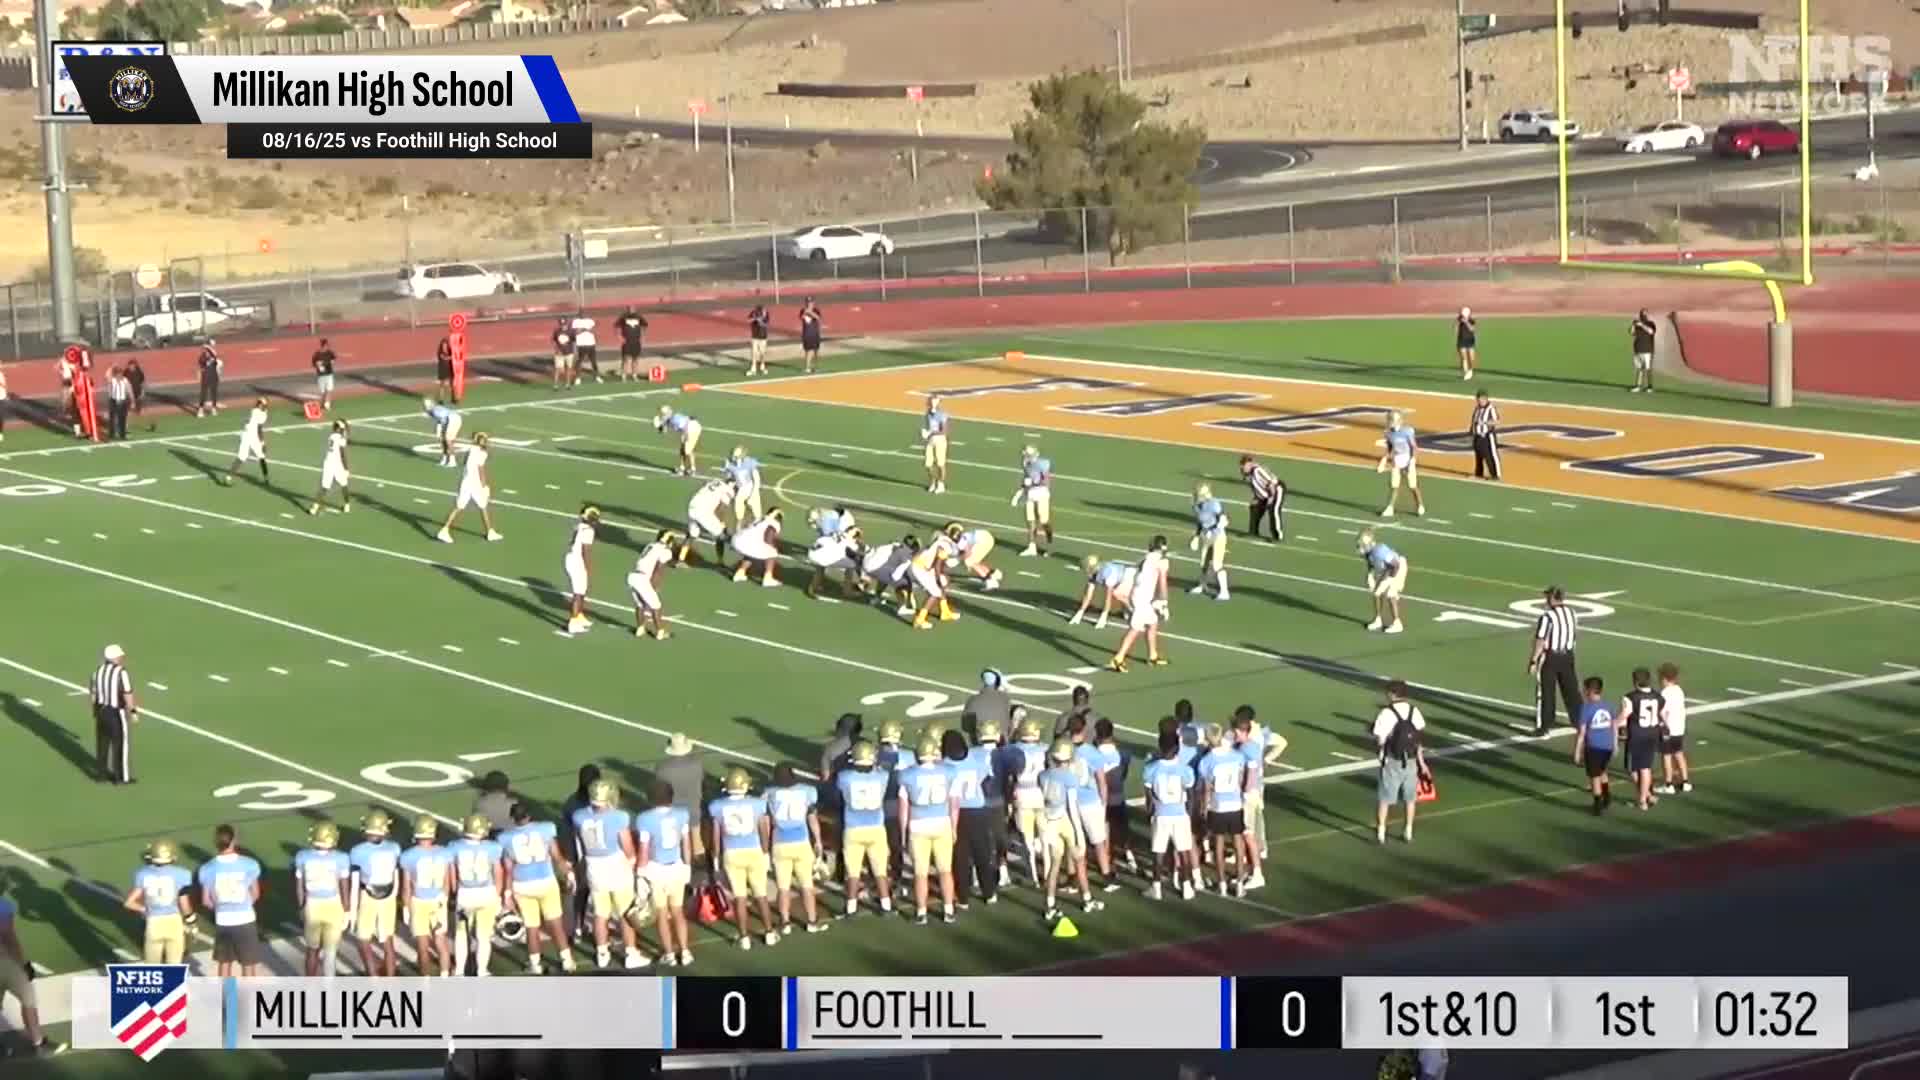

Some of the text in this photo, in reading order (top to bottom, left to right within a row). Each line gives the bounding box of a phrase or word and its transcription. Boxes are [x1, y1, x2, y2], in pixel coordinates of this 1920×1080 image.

[1433, 597, 1616, 629] 10
[860, 672, 1093, 718] 20
[1639, 699, 1658, 727] 51
[213, 760, 475, 810] 30
